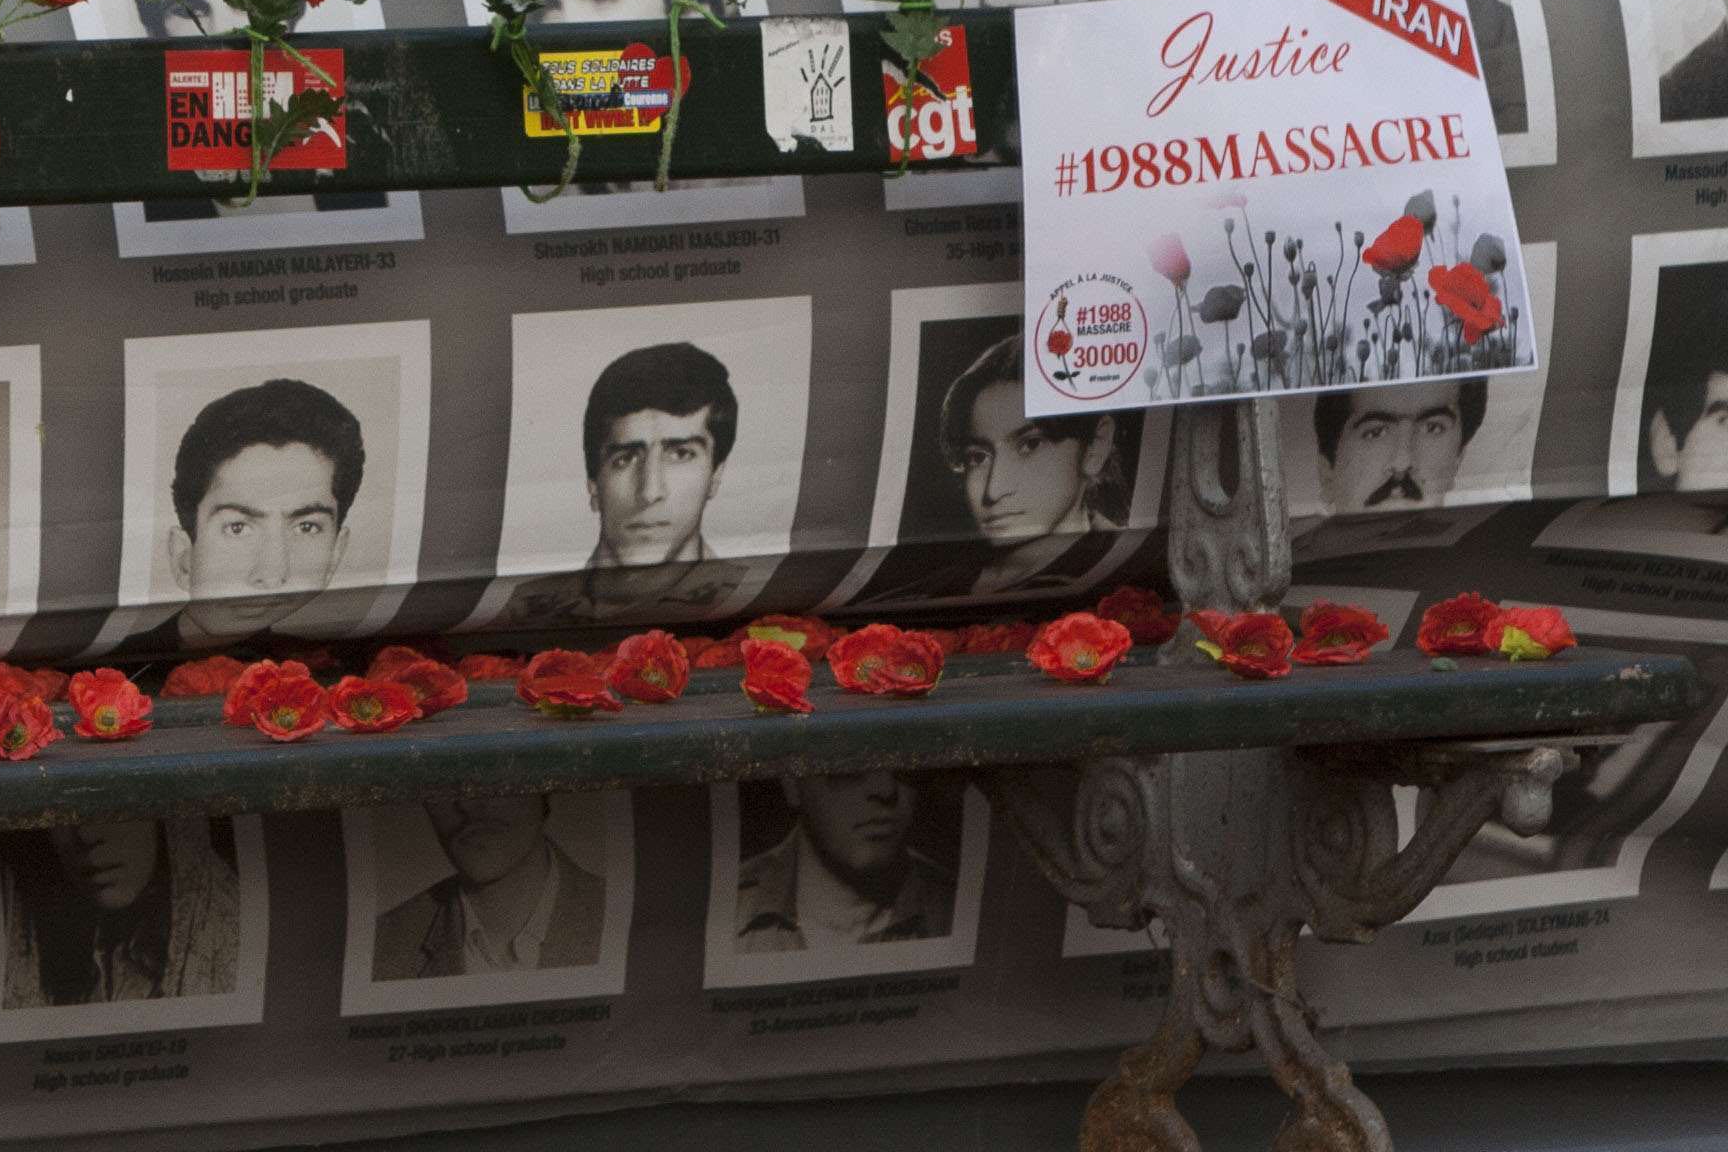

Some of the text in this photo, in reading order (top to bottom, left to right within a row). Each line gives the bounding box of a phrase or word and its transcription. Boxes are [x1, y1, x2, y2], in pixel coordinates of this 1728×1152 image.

[582, 58, 656, 73] SOLIDAIRES
[1147, 11, 1352, 118] Justice
[591, 77, 607, 90] LA
[170, 92, 208, 118] EN
[887, 86, 975, 159] cgt
[1054, 113, 1471, 198] #1988MASSACRE
[1664, 161, 1728, 182] Massoud
[1695, 186, 1728, 208] High
[534, 239, 608, 260] Shahrokh
[153, 264, 214, 283] Hossein
[217, 259, 288, 279] NAMDAR
[580, 257, 742, 286] High school graduate
[1085, 272, 1097, 282] LA
[194, 281, 359, 310] High school graduate
[1077, 303, 1132, 325] #1988
[1077, 321, 1132, 336] MASSACRE
[1454, 939, 1579, 969] High school student
[450, 1039, 499, 1058] school
[33, 1063, 190, 1092] High school graduate
